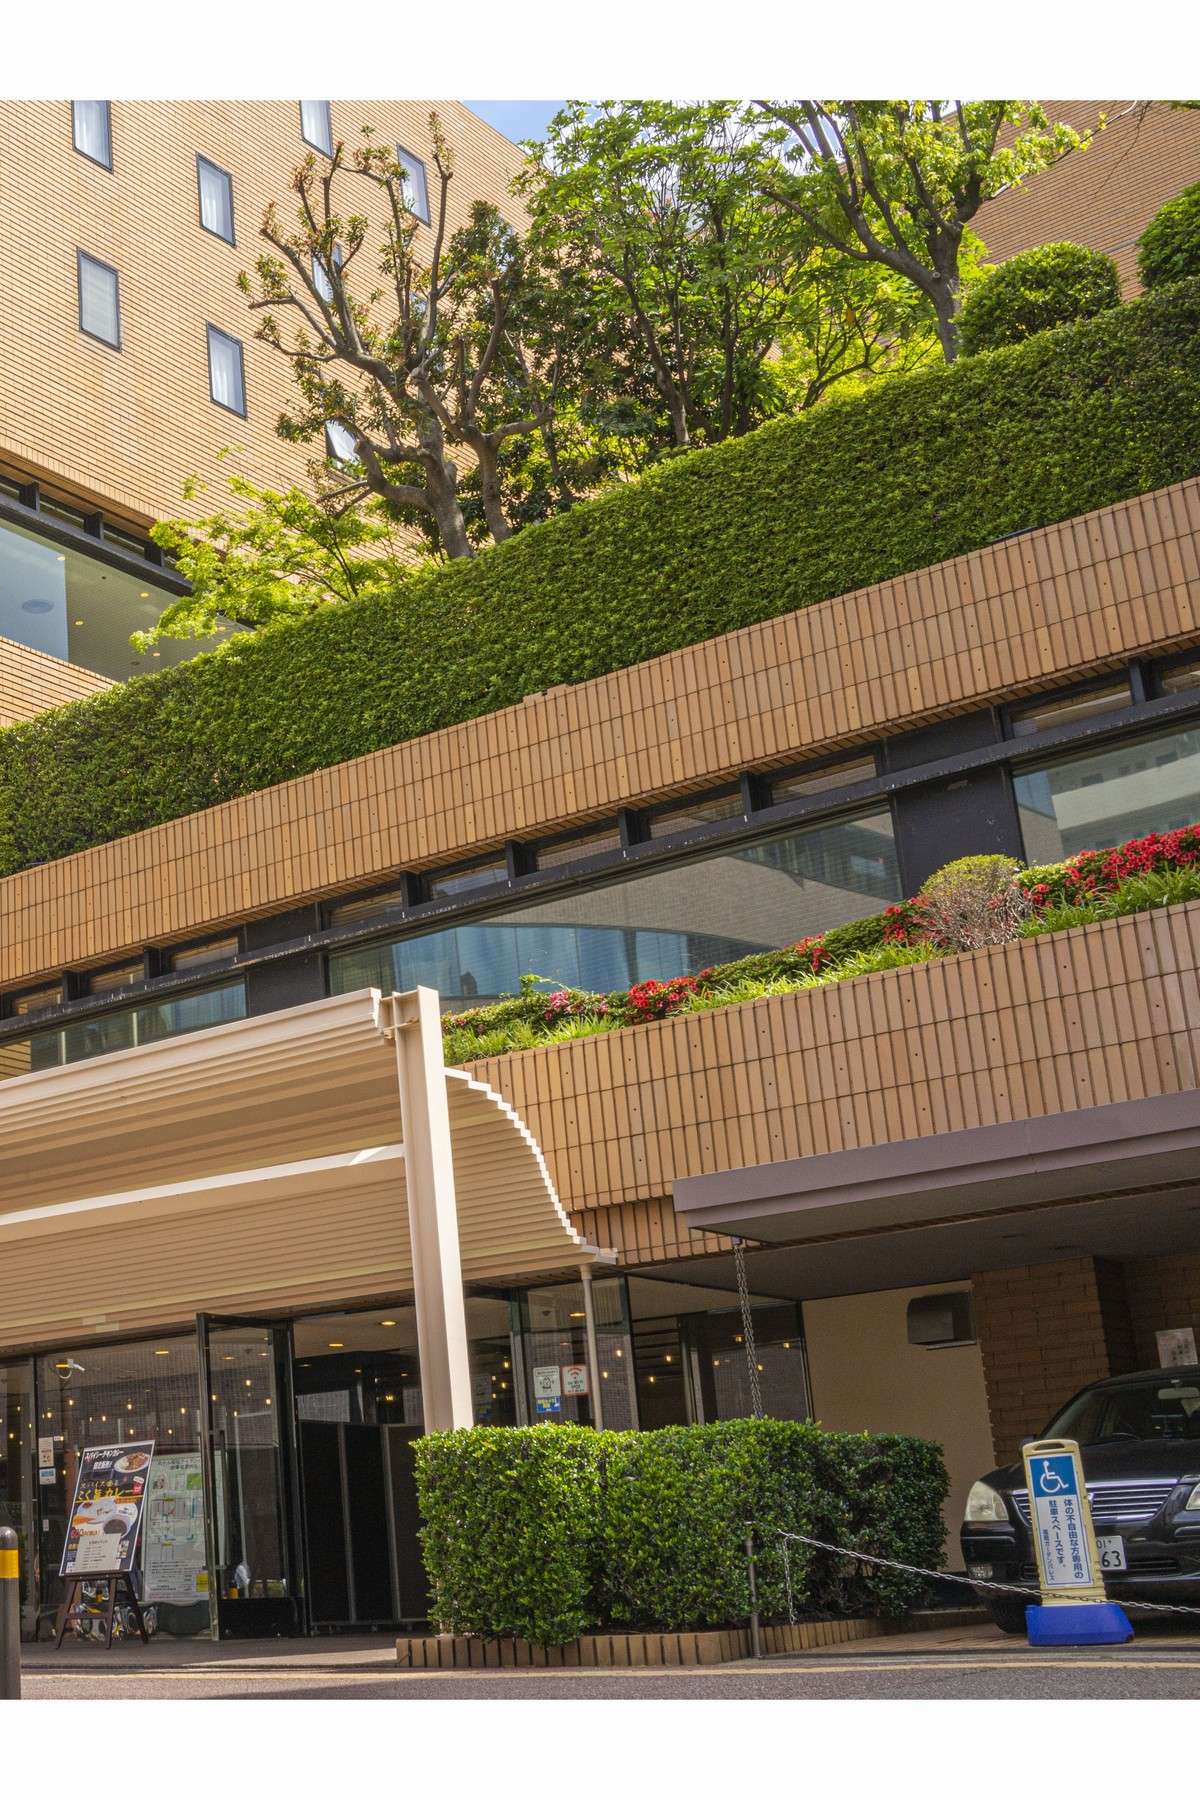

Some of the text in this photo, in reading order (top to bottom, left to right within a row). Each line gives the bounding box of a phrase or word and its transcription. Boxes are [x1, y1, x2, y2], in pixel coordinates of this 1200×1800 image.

[1048, 1499, 1067, 1568] 駐車スペースです。
[1062, 1498, 1084, 1580] 体の不自由な方専用の
[1102, 1550, 1121, 1568] 63
